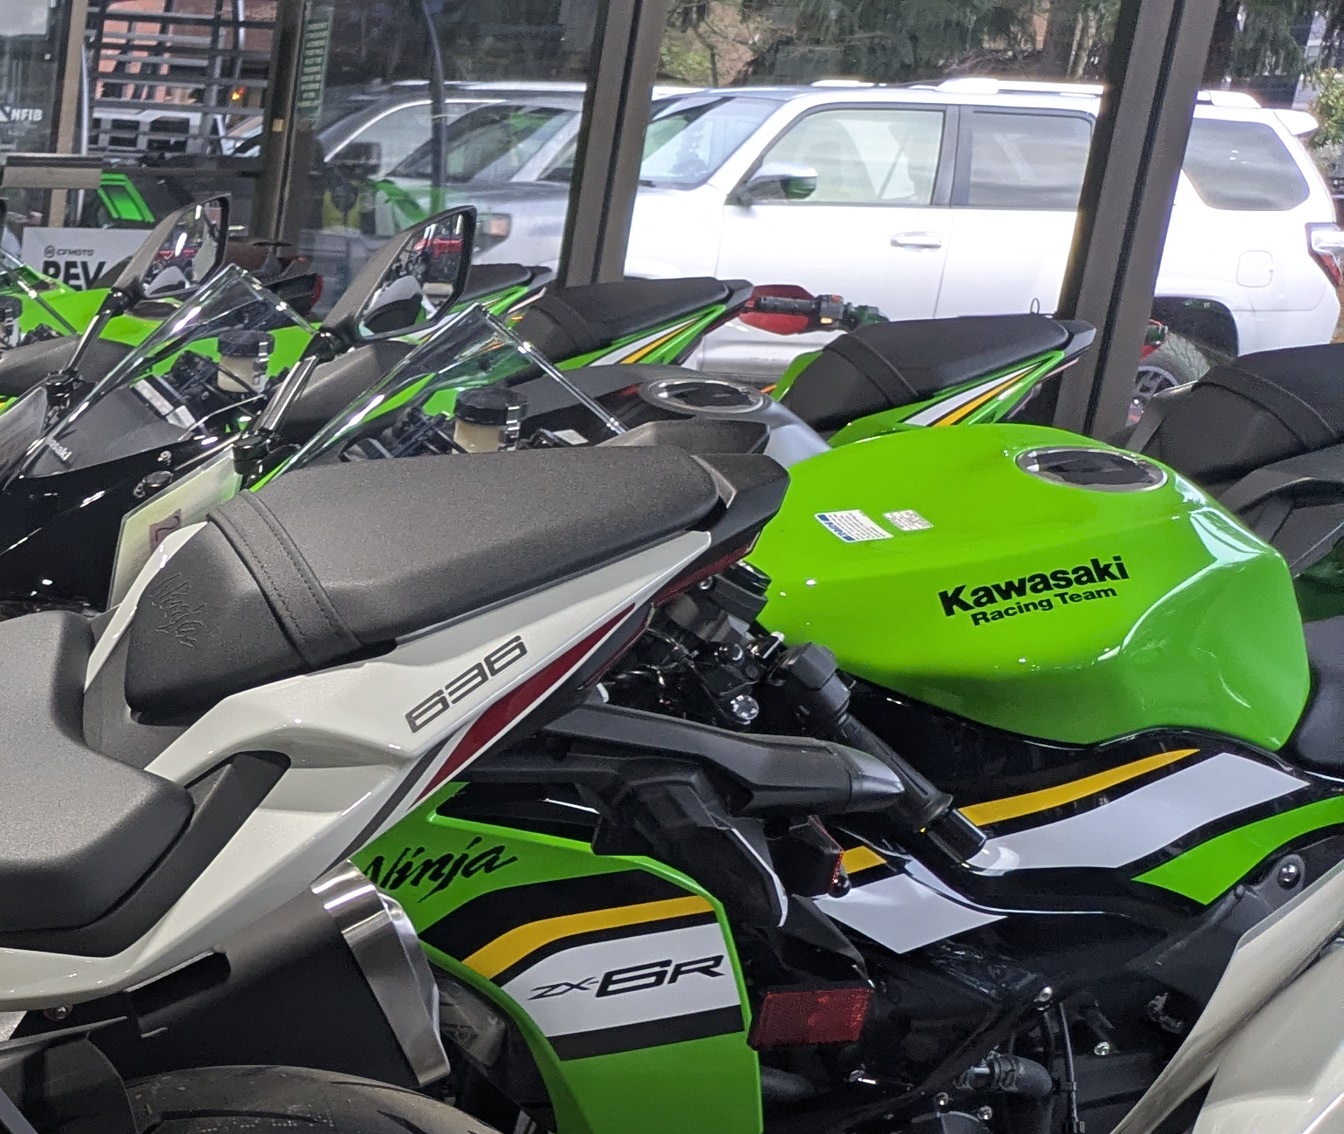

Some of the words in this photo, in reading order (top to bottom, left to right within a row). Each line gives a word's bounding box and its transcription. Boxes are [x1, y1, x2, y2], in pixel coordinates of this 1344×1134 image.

[10, 106, 44, 122] NFIB
[56, 248, 94, 257] CFMOTO
[938, 555, 1131, 618] Kawasaki
[970, 596, 1055, 626] Racing
[1054, 585, 1119, 609] Team
[405, 635, 529, 734] 636
[362, 836, 518, 904] Ninja
[527, 954, 726, 1001] ZX-6R
